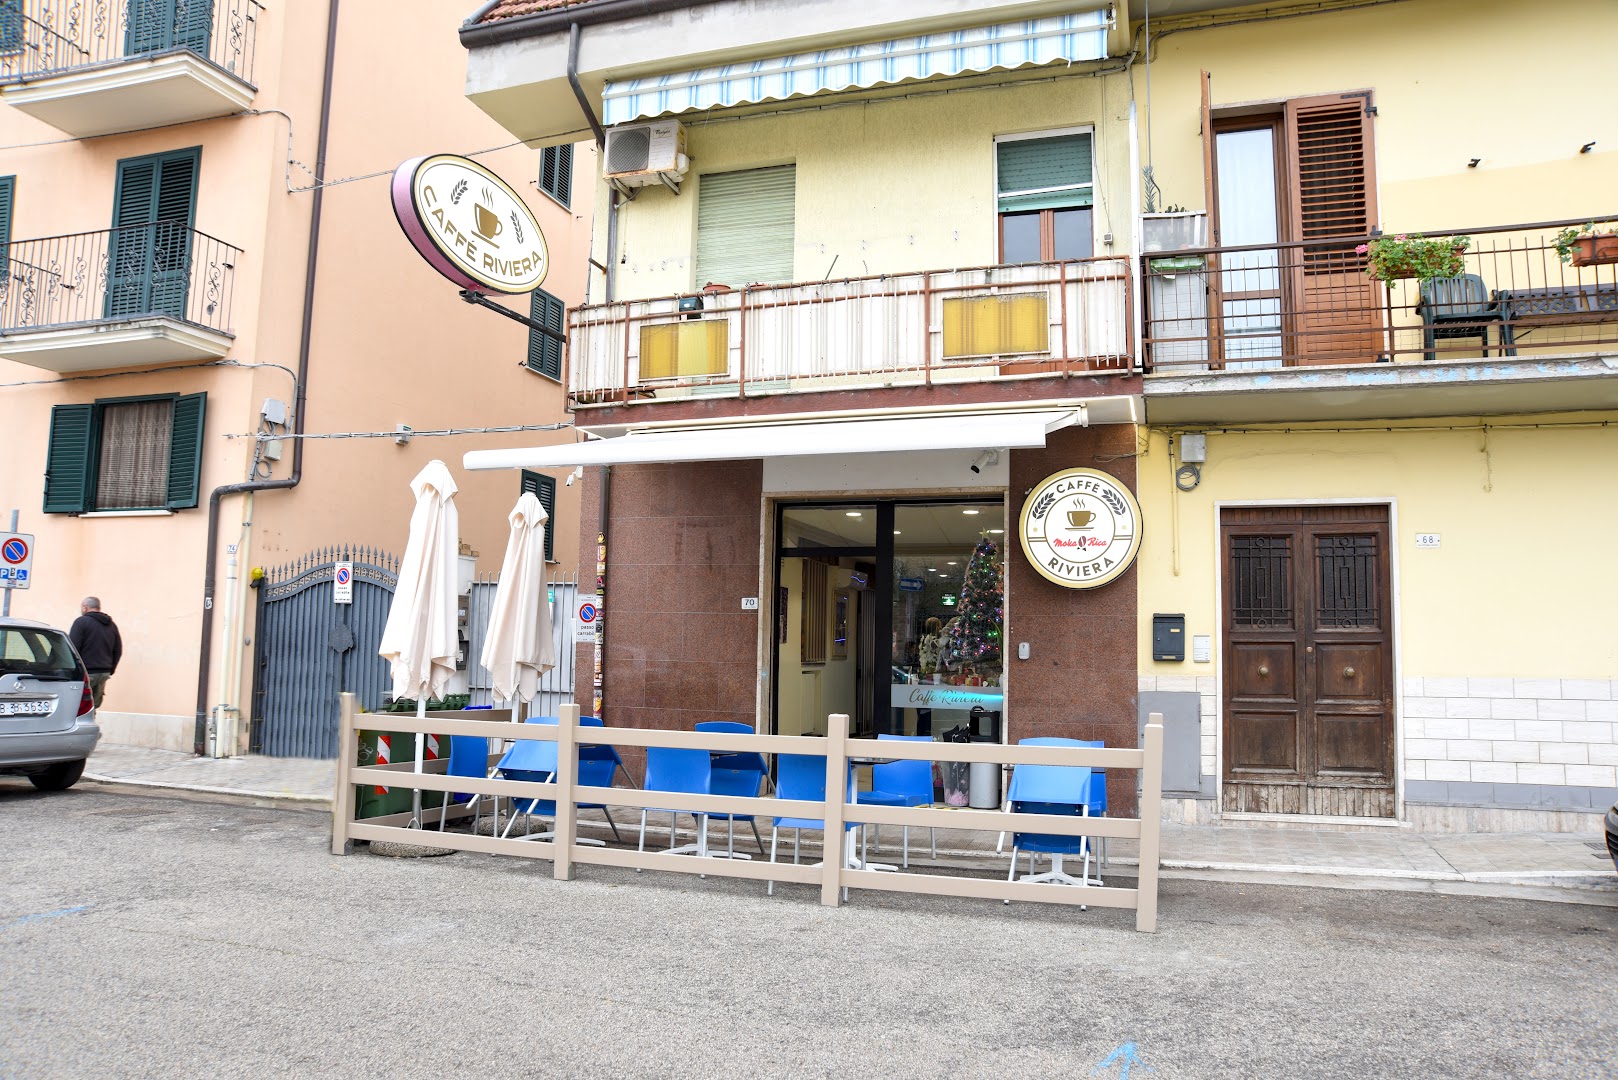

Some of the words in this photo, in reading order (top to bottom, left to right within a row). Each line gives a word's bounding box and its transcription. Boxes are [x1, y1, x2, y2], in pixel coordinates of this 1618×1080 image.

[483, 250, 542, 277] RIVIERA
[1053, 538, 1078, 547] Moka
[1087, 537, 1107, 547] Rica
[1423, 536, 1434, 544] 68
[1047, 557, 1115, 577] RIVIERA
